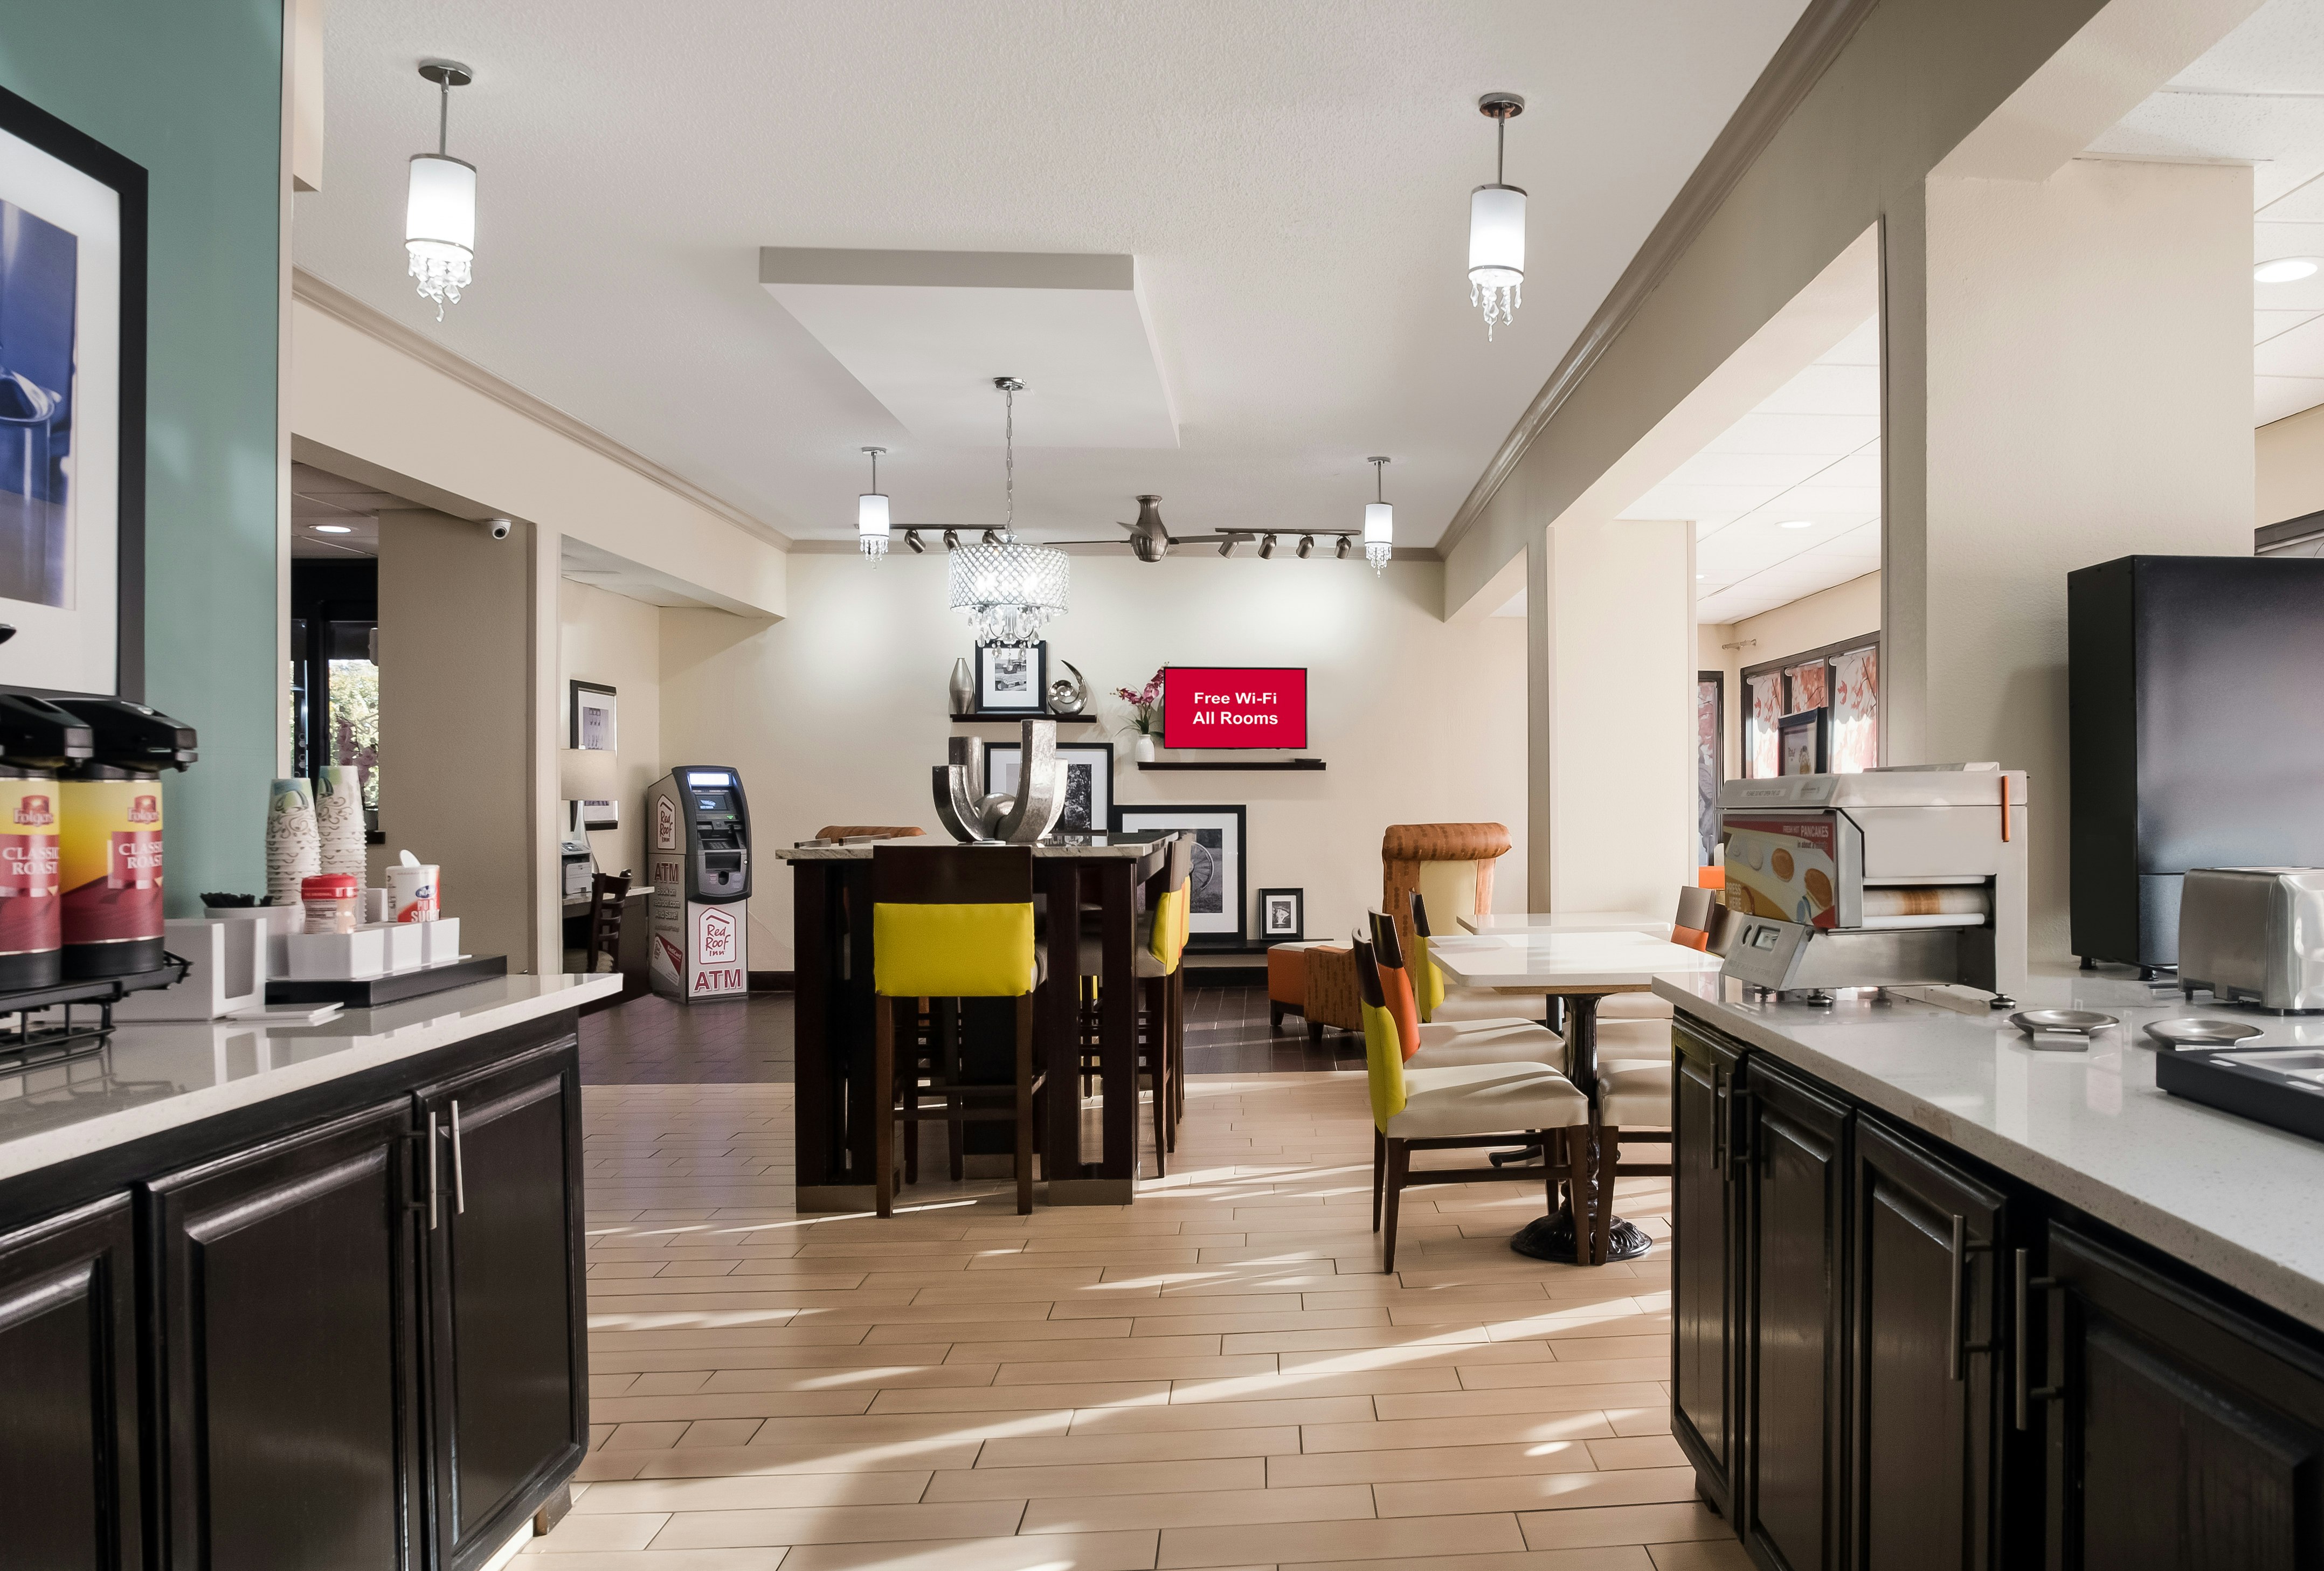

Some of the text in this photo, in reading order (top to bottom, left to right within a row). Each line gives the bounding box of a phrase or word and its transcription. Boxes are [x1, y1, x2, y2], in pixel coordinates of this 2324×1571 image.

[1194, 692, 1277, 704] Free Wi-Fi
[1192, 711, 1278, 725] All Rooms
[661, 810, 671, 823] Red
[660, 822, 673, 838] Roof
[1801, 825, 1829, 838] PANCAKES
[2, 847, 59, 861] CLASSI
[119, 841, 163, 856] CLASSI
[12, 861, 57, 875] ROAST
[654, 862, 678, 883] ATM
[1726, 882, 1741, 895] PRESS
[1729, 896, 1741, 910] HERE
[707, 924, 727, 937] Red
[706, 934, 731, 951] Roof
[694, 968, 741, 991] ATM
